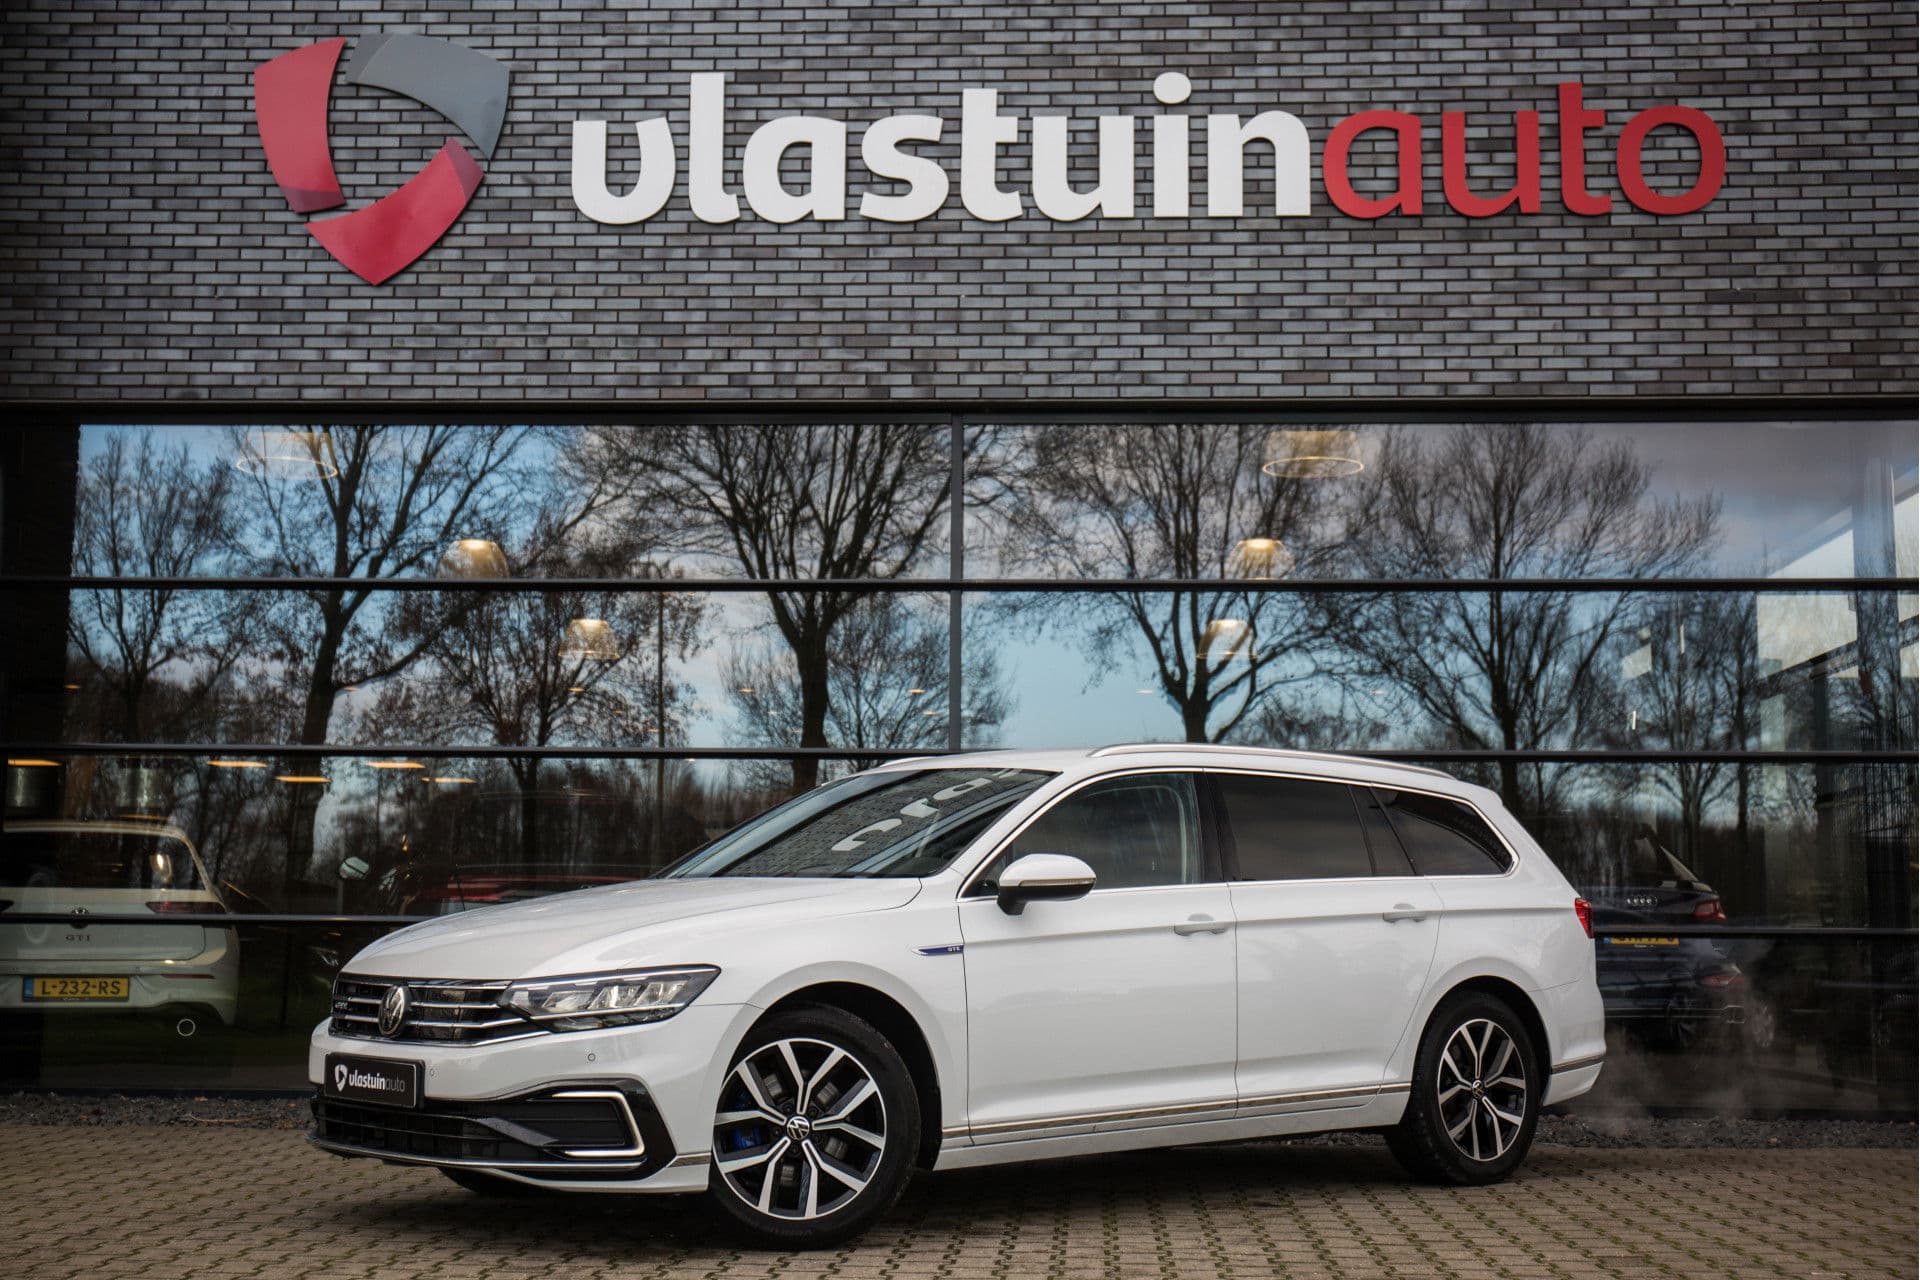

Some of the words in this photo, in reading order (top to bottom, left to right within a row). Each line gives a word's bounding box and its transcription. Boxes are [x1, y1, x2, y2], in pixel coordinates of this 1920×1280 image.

[571, 71, 1726, 225] vlastuinauto
[65, 934, 91, 942] GTI
[41, 980, 121, 995] L-232-RS
[349, 1069, 405, 1092] vlastuinauto
